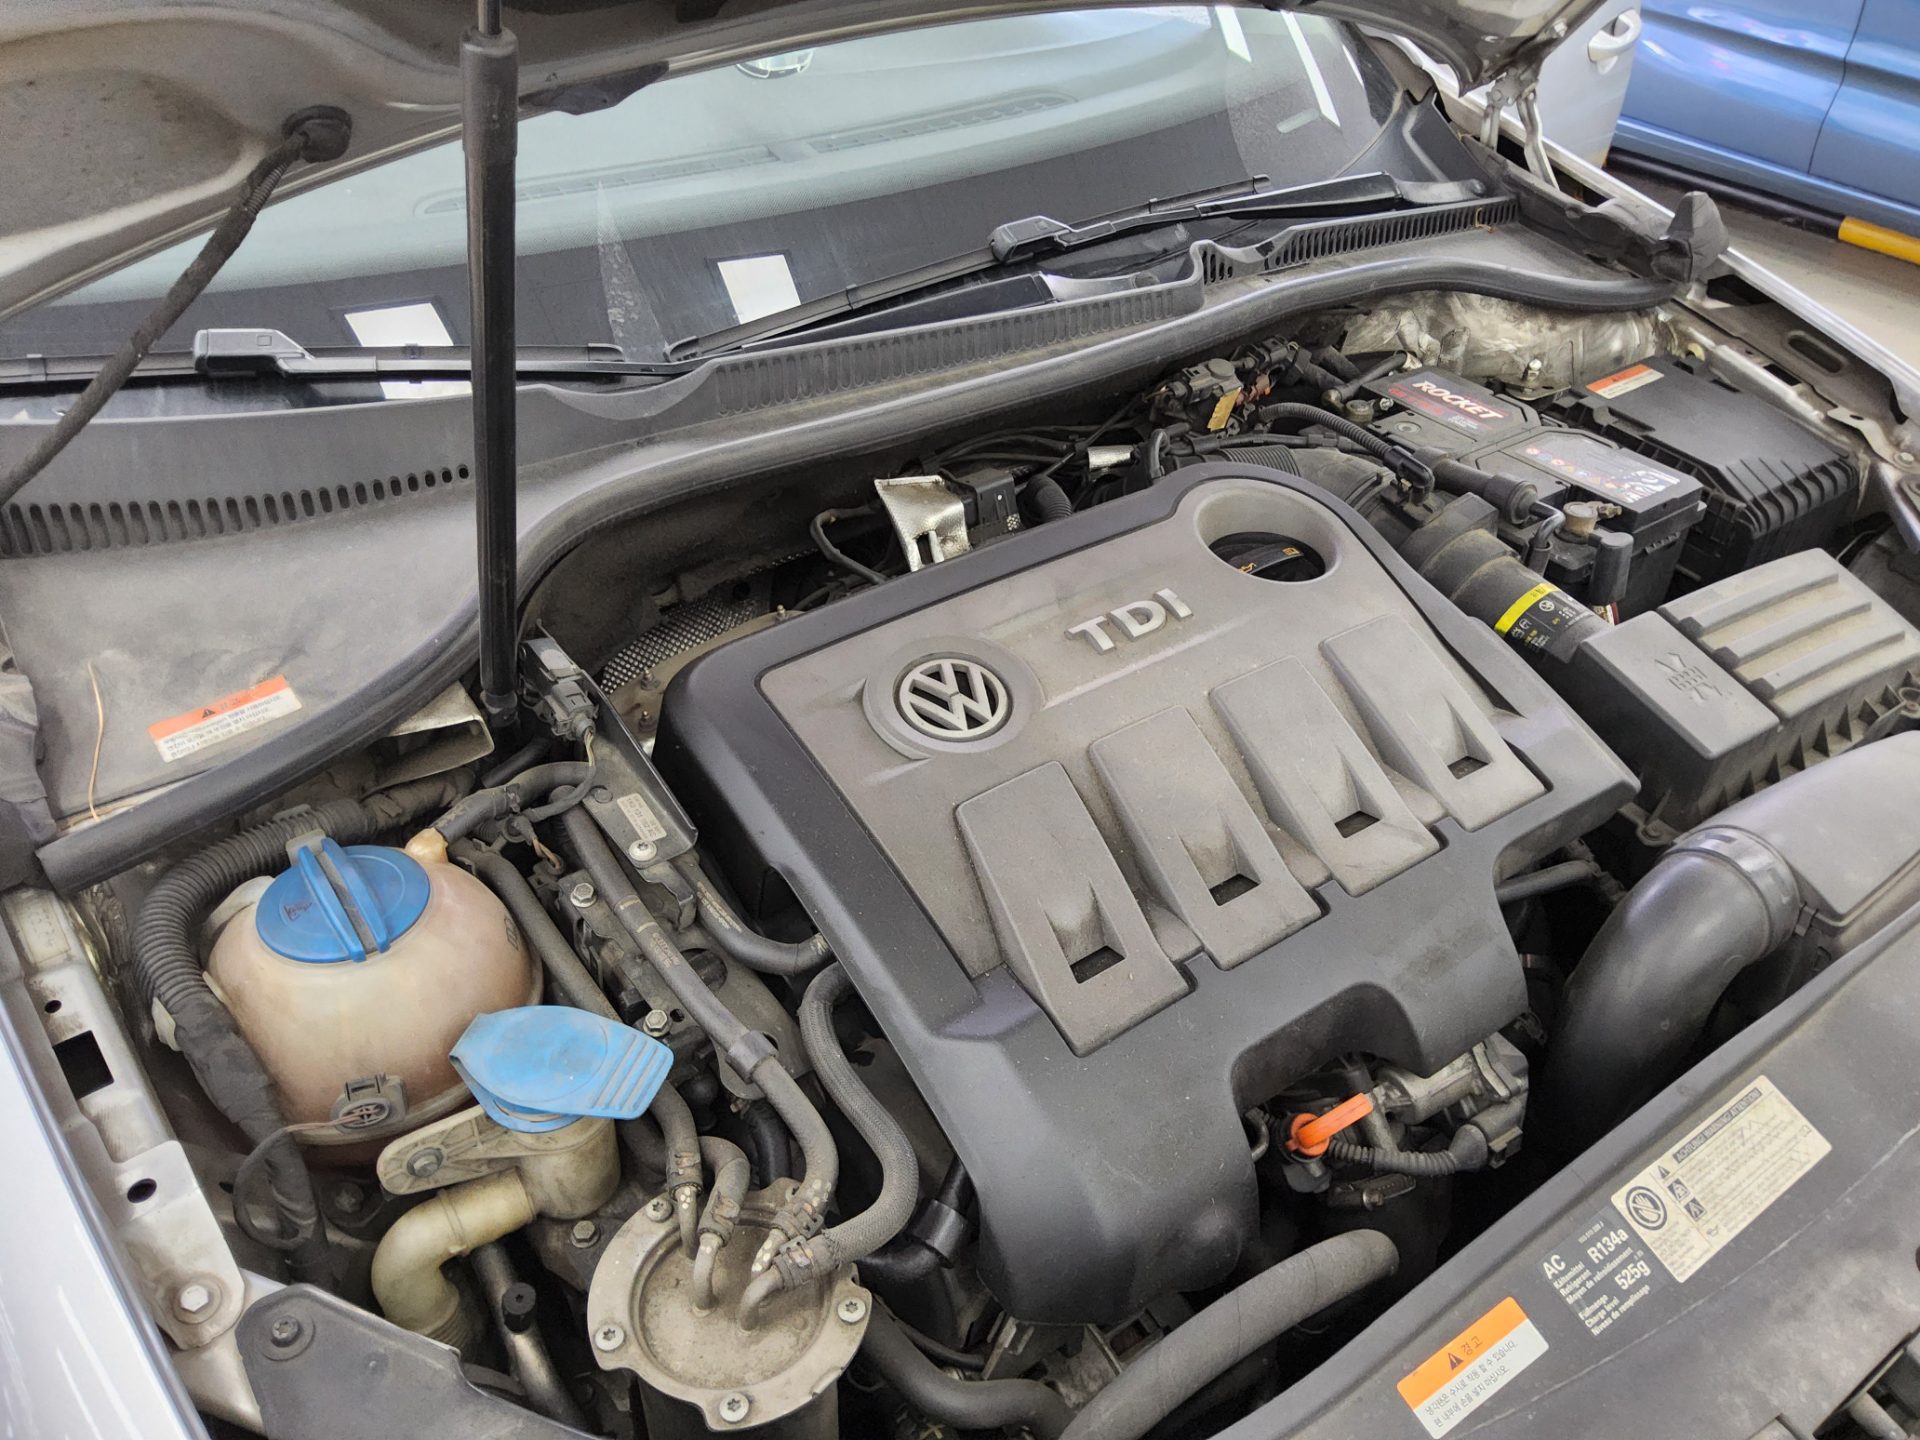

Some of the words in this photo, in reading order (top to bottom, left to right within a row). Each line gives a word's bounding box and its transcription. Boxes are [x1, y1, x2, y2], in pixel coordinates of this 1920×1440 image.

[1412, 380, 1504, 419] ROCKET
[1064, 587, 1193, 655] TDI
[1587, 1228, 1629, 1264] R134a
[1542, 1254, 1566, 1280] AC
[1614, 1260, 1651, 1290] 525g
[1585, 1279, 1595, 1289] de
[1611, 1310, 1620, 1320] de
